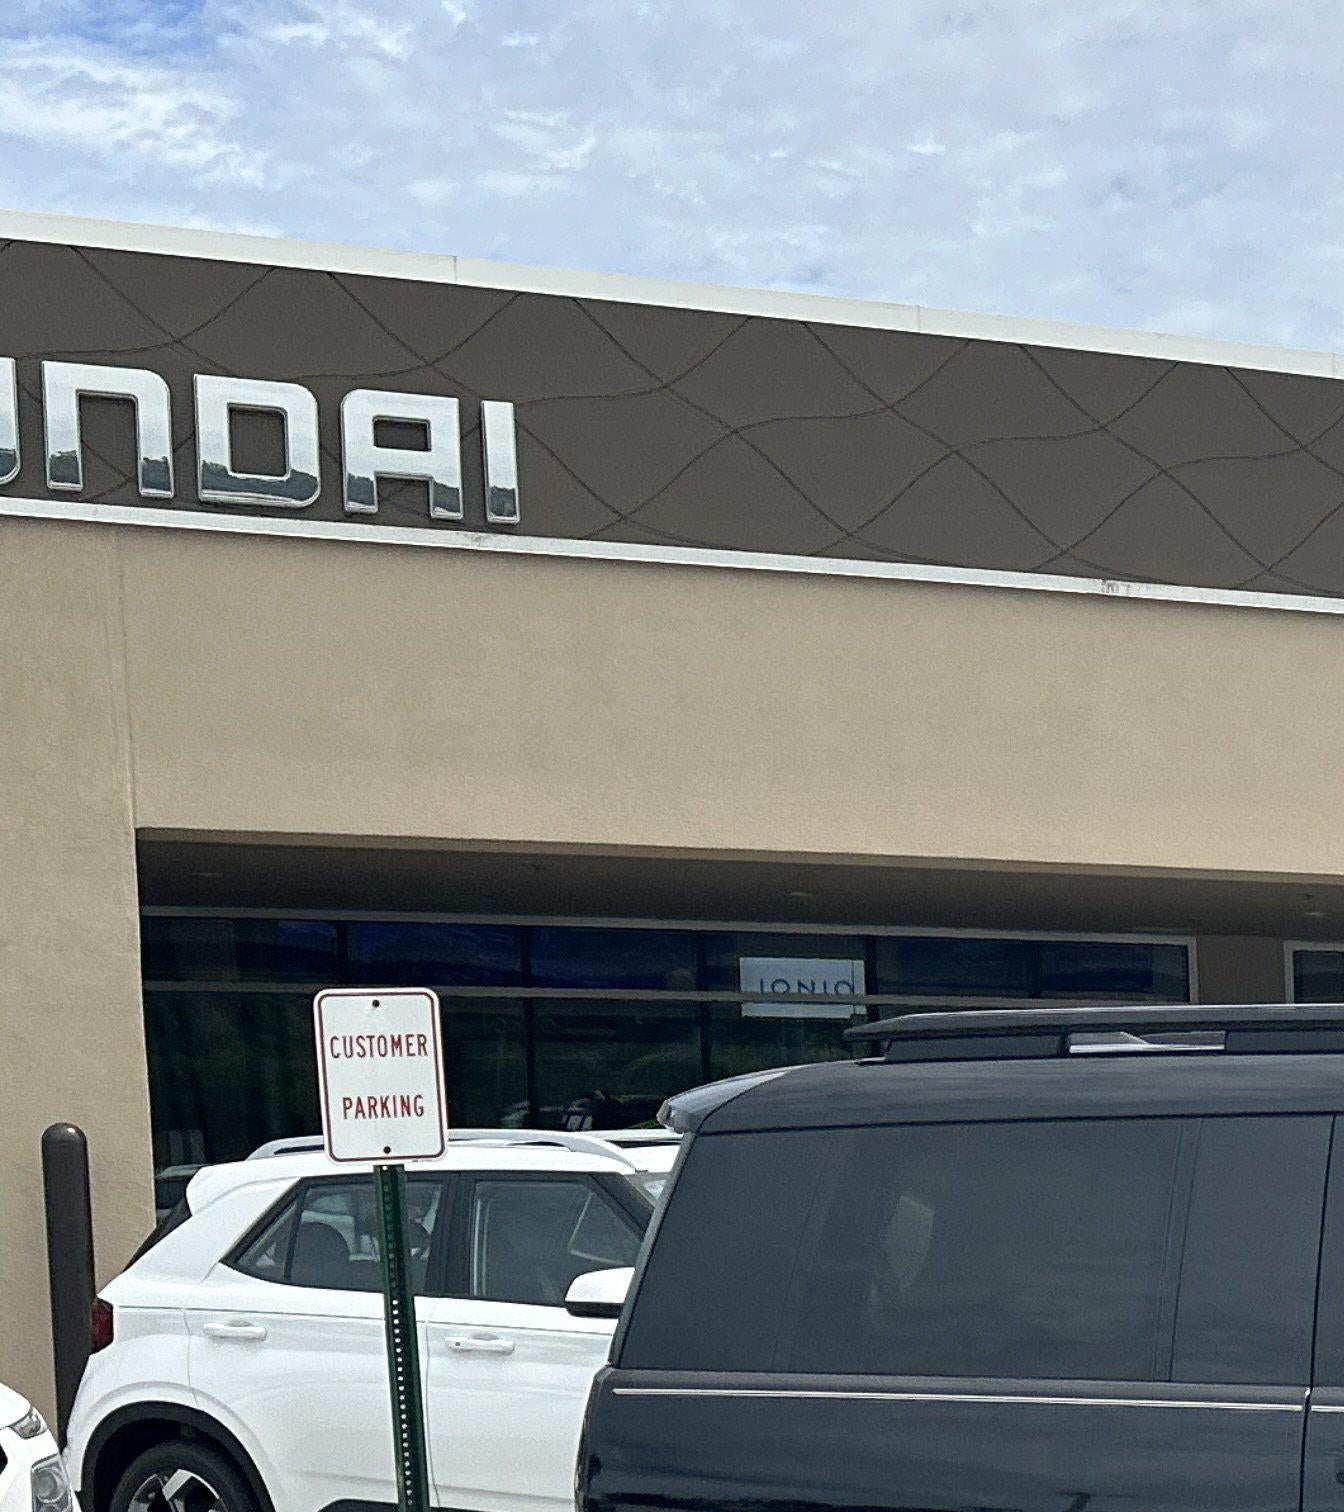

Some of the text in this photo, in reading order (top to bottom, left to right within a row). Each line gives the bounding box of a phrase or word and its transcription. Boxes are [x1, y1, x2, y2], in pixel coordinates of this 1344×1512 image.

[0, 356, 519, 524] NDAI
[329, 1033, 429, 1059] CUSTOMER
[342, 1094, 425, 1120] PARKING
